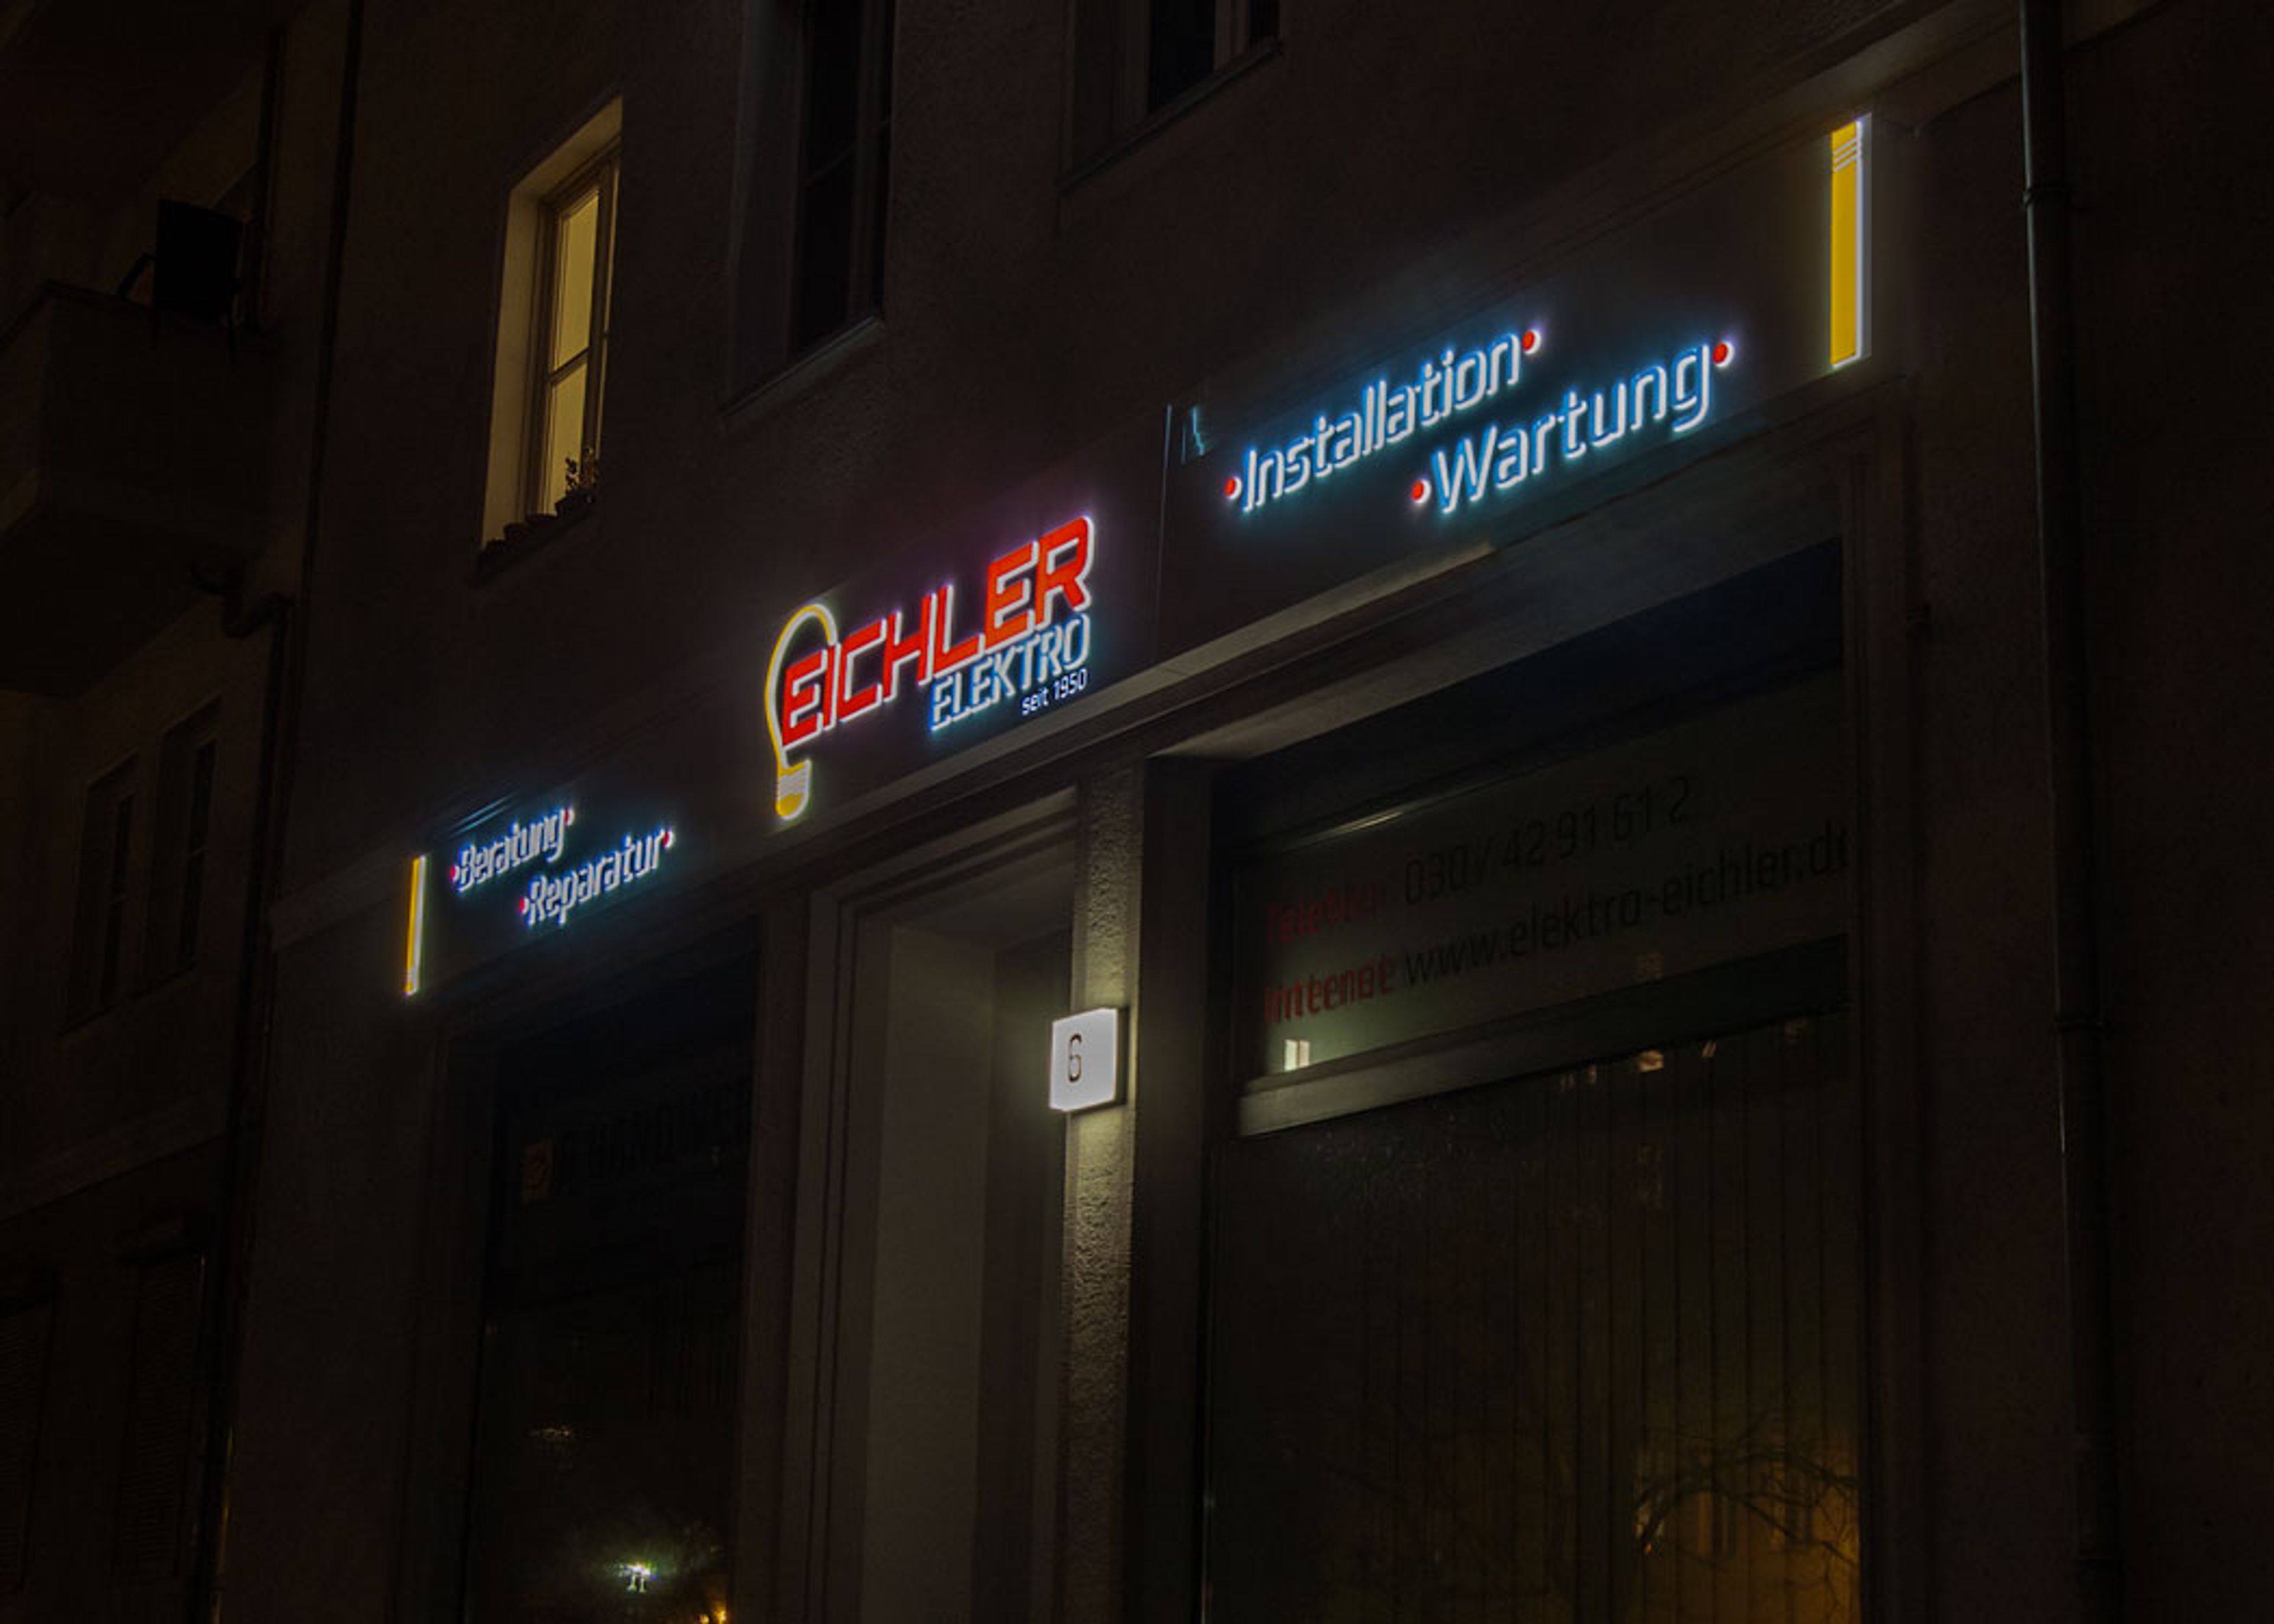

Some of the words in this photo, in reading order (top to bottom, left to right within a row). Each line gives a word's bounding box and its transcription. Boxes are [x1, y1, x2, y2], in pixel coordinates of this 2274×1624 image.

[1244, 333, 1520, 512] Installation
[1433, 343, 1711, 513] Wartung
[782, 516, 1094, 750] EICHLER
[929, 613, 1090, 731] ELEKTRO
[1022, 687, 1048, 715] seit
[1054, 668, 1087, 700] 1950
[458, 809, 564, 892] Beratung
[526, 829, 665, 925] Reparatur
[1068, 1034, 1081, 1083] 6
